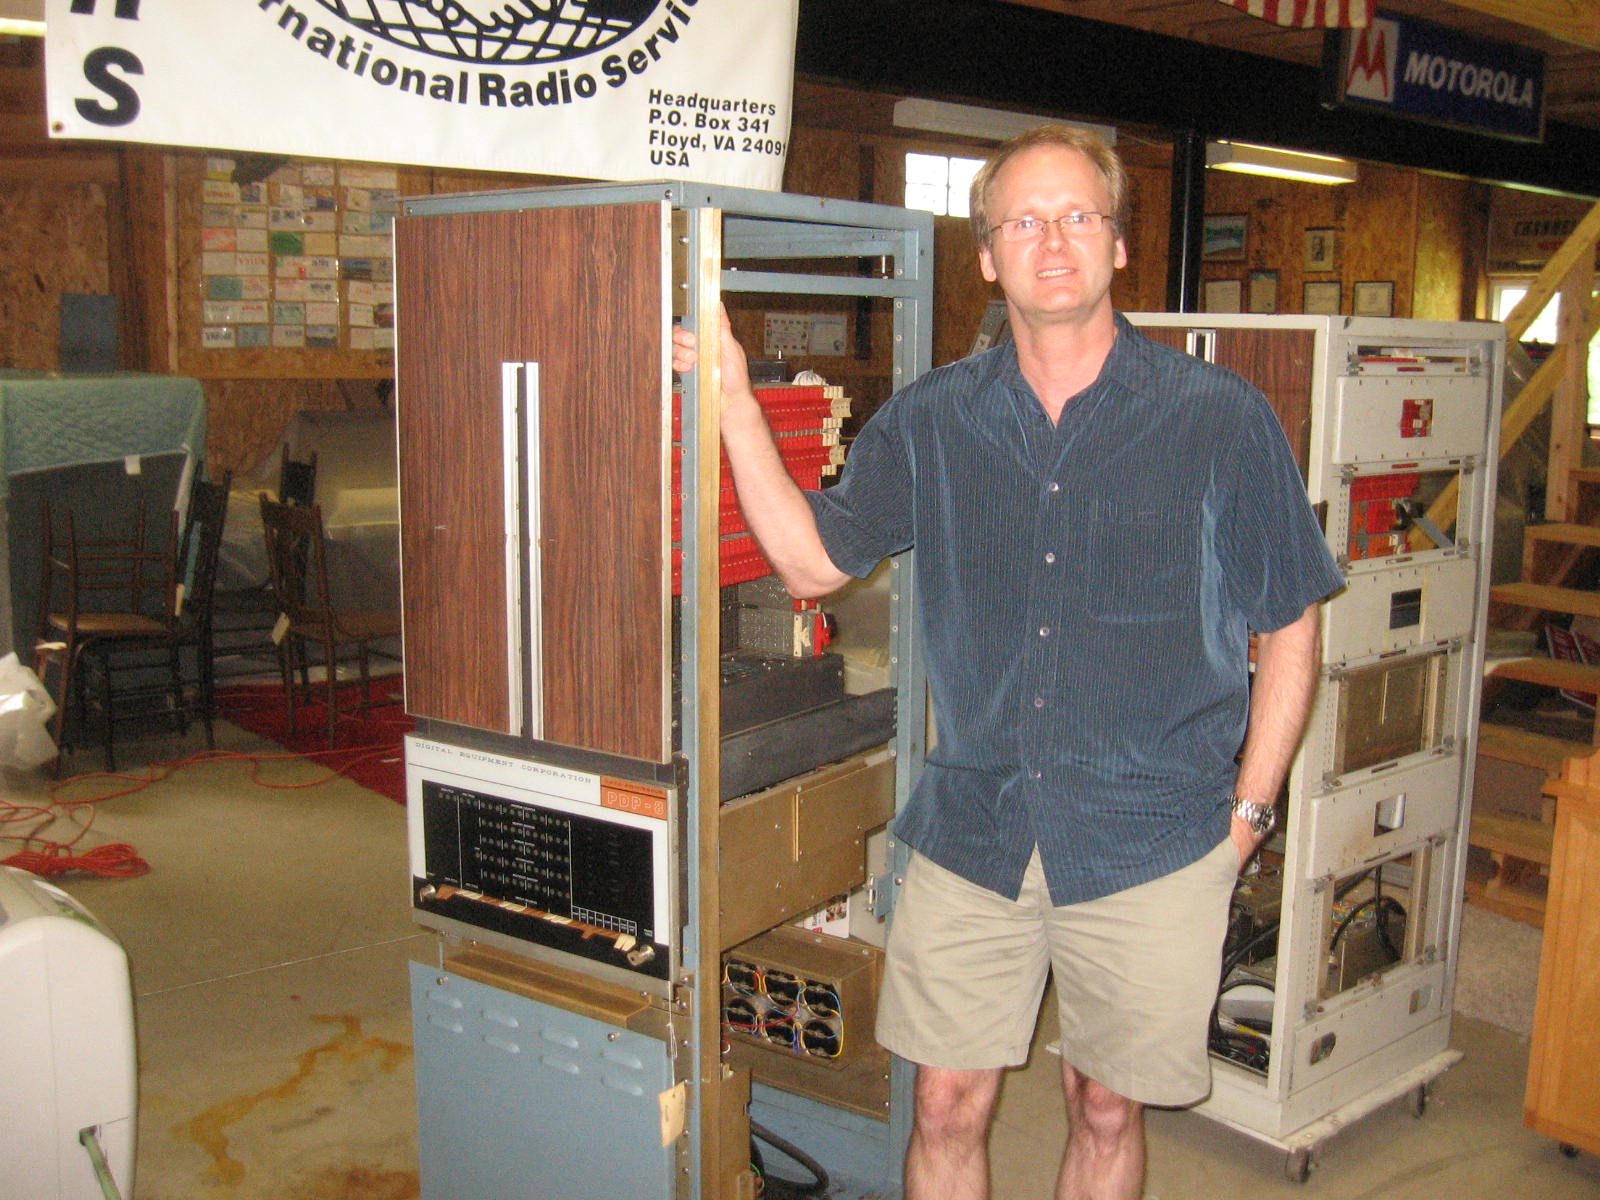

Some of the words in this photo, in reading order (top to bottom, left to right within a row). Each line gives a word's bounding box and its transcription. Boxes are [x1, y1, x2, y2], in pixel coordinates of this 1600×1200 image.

[70, 0, 144, 127] S
[479, 69, 597, 107] Radio
[602, 0, 699, 88] Servi
[1404, 51, 1534, 109] MOTOROLA
[649, 88, 776, 116] Headquarters
[649, 109, 687, 127] P.O.
[695, 113, 730, 131] Box
[737, 116, 769, 134] 341
[649, 130, 707, 152] Floyd,
[713, 135, 735, 151] VA
[650, 150, 690, 168] USA
[415, 742, 453, 755] DIGITAL
[459, 751, 514, 768] EQUIPMENT
[521, 764, 592, 784] CORPORATION
[607, 791, 664, 815] PDP-8
